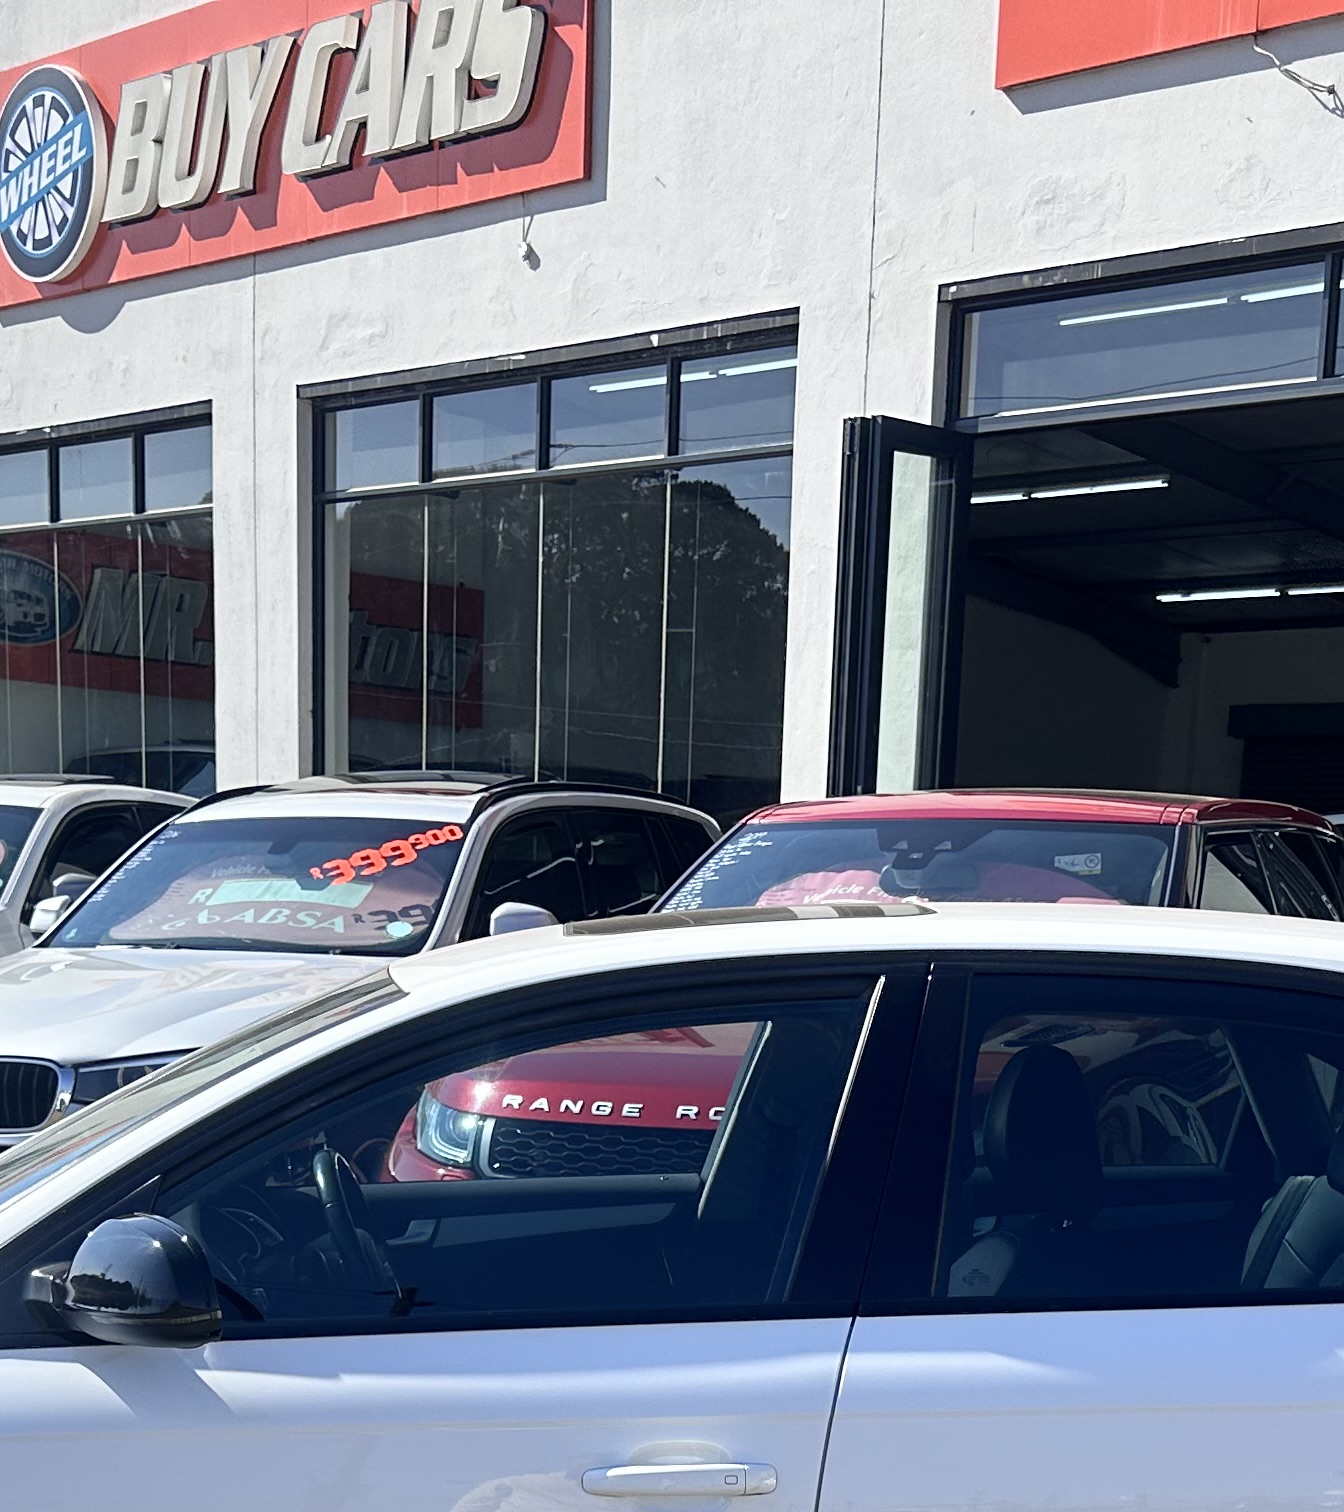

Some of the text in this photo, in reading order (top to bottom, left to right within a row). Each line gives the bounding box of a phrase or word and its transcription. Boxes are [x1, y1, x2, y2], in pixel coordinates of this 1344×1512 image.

[100, 0, 546, 223] BUY CARS
[187, 889, 214, 905] R
[222, 908, 346, 934] ABSA
[501, 1094, 644, 1118] RANGE
